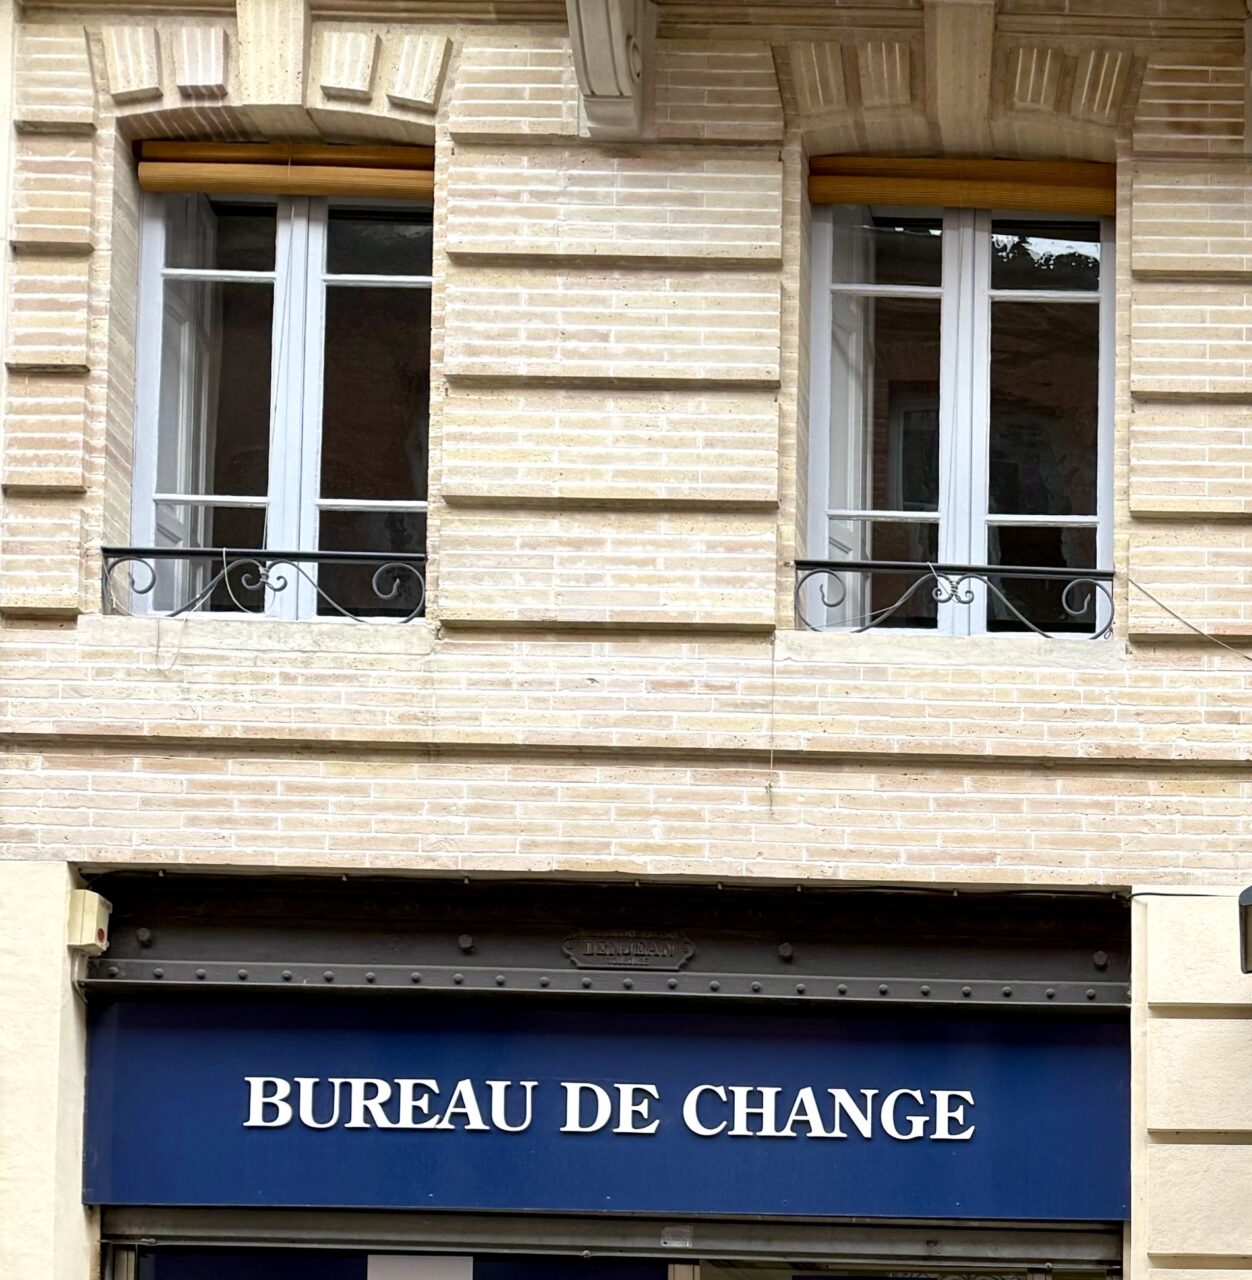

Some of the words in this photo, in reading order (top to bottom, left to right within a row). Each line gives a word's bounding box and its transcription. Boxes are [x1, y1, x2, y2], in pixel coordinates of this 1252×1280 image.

[243, 1076, 537, 1131] BUREAU
[561, 1084, 659, 1135] DE
[683, 1085, 975, 1140] CHANGE
